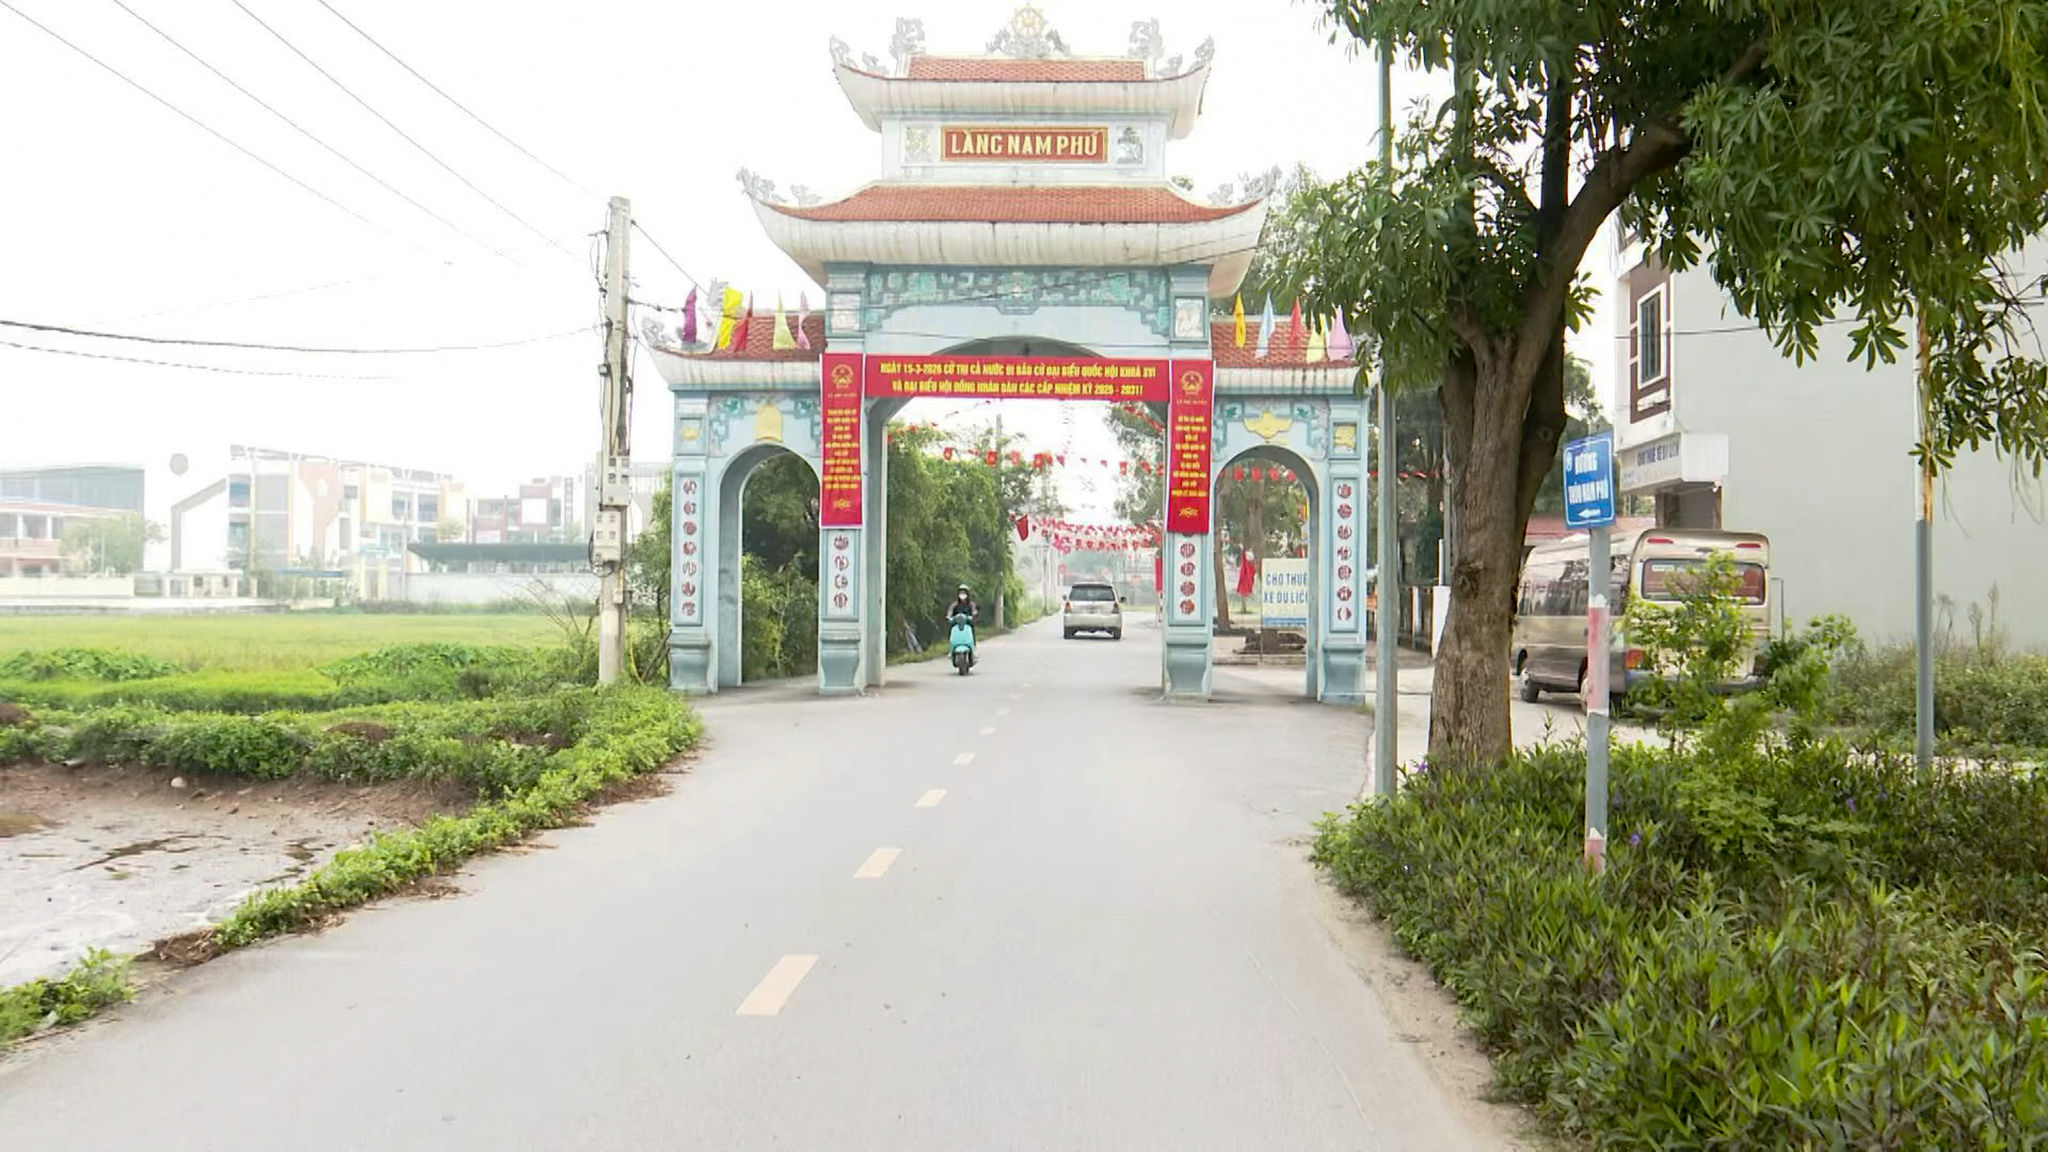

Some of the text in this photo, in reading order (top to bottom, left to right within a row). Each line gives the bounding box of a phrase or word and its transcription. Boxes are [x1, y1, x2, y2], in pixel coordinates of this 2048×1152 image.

[951, 130, 1099, 155] LÀNG NAM PHÚ
[1266, 573, 1284, 586] CHO
[1264, 592, 1274, 603] XE
